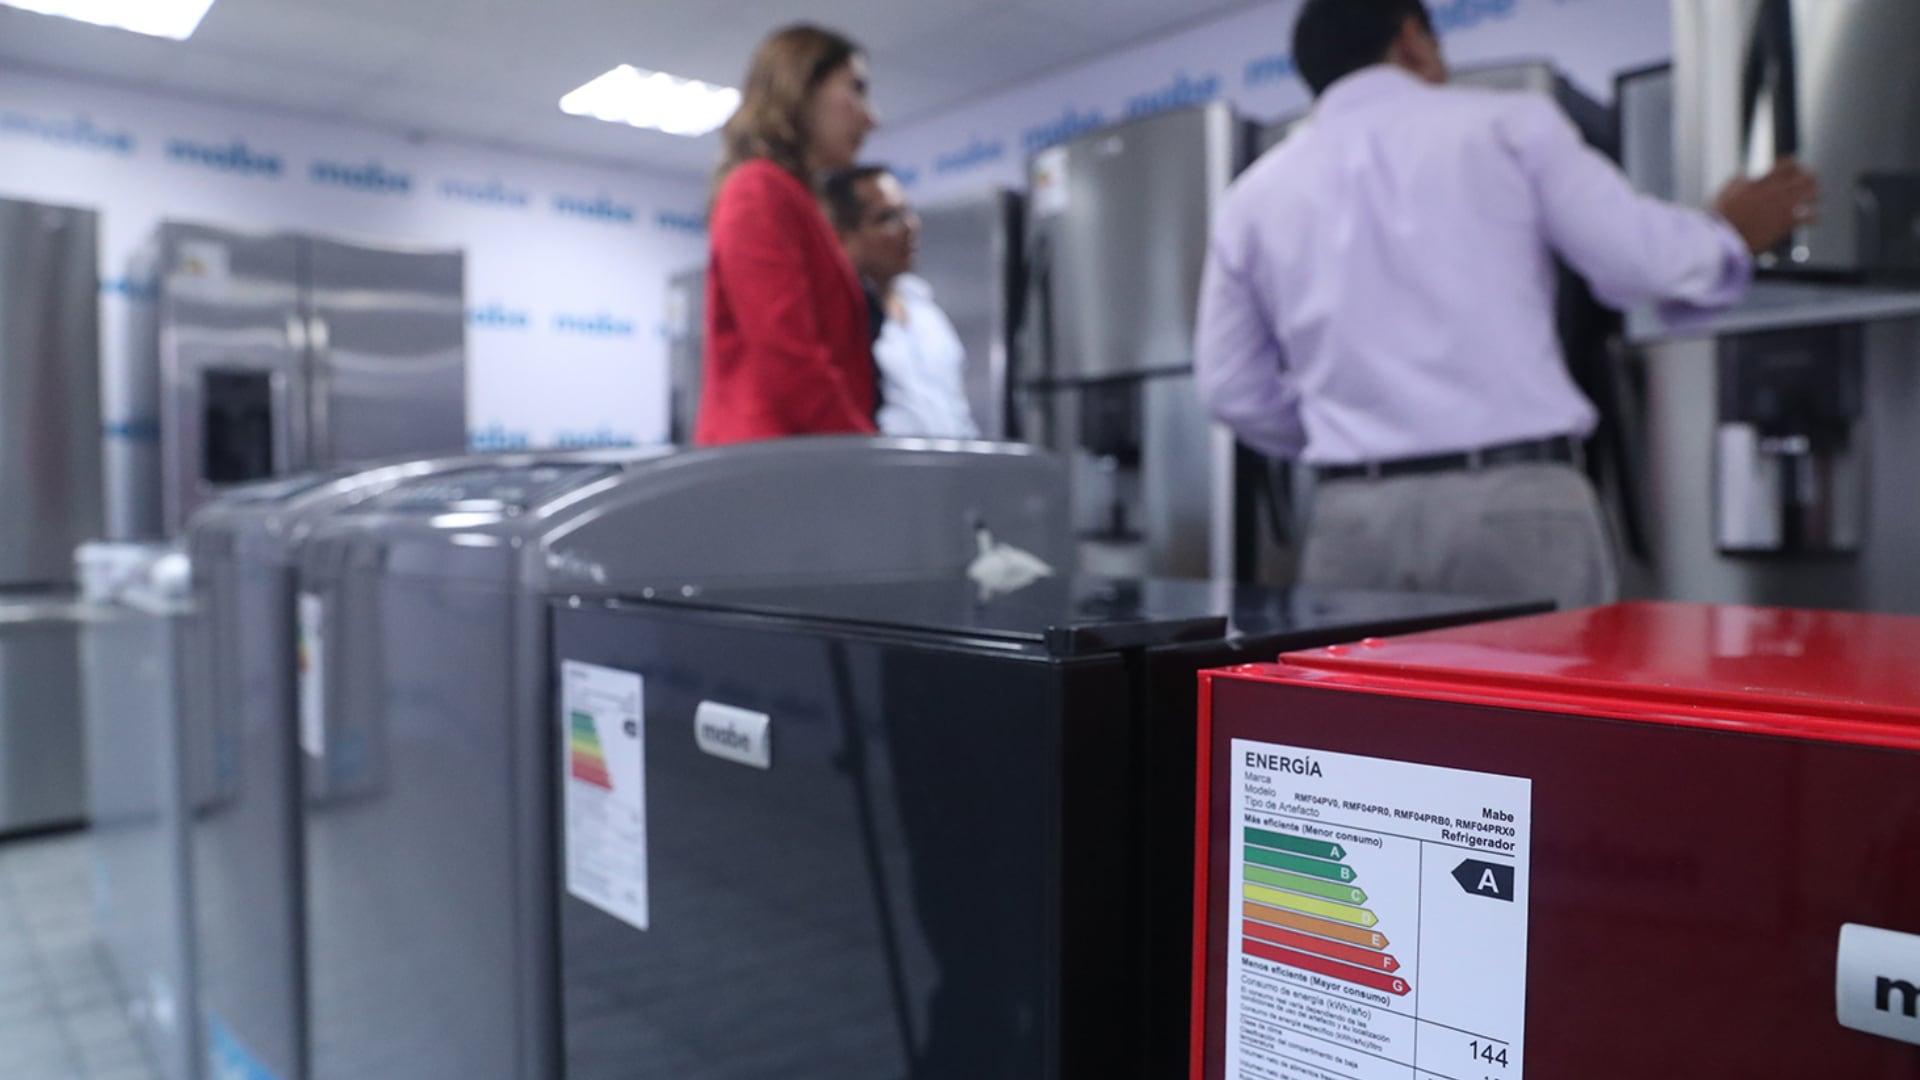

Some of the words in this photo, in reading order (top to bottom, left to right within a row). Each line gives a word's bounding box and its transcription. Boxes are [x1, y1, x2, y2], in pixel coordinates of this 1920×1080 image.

[702, 721, 750, 753] mabe
[1245, 751, 1323, 778] ENERGÍA
[1244, 771, 1272, 785] Marca
[1244, 783, 1277, 798] Modelo
[1244, 795, 1263, 808] Tipo
[1265, 801, 1277, 810] de
[1278, 802, 1320, 818] Artefacto
[1482, 807, 1515, 822] Mabe
[1244, 813, 1261, 825] Más
[1263, 816, 1300, 832] eficiente
[1302, 823, 1334, 839] (Menor
[1335, 831, 1383, 849] consumo)
[1393, 809, 1453, 828] RMF04PRB0,
[1455, 818, 1515, 837] RMF04PRX0
[1441, 828, 1516, 851] Refrigerador
[1329, 845, 1340, 858] A
[1340, 866, 1350, 880] B
[1477, 868, 1500, 894] A
[1351, 888, 1361, 902] C
[1361, 911, 1371, 924] D
[1371, 933, 1381, 947] E
[1383, 956, 1392, 969] F
[1240, 974, 1279, 993] Consumo
[1280, 986, 1291, 997] de
[1292, 991, 1324, 1006] energía
[1241, 956, 1269, 972] Menos
[1271, 964, 1308, 983] eficiente
[1310, 974, 1341, 991] (Mayor
[1343, 985, 1391, 1007] consumo)
[1392, 979, 1403, 992] G
[1469, 1040, 1509, 1068] 144
